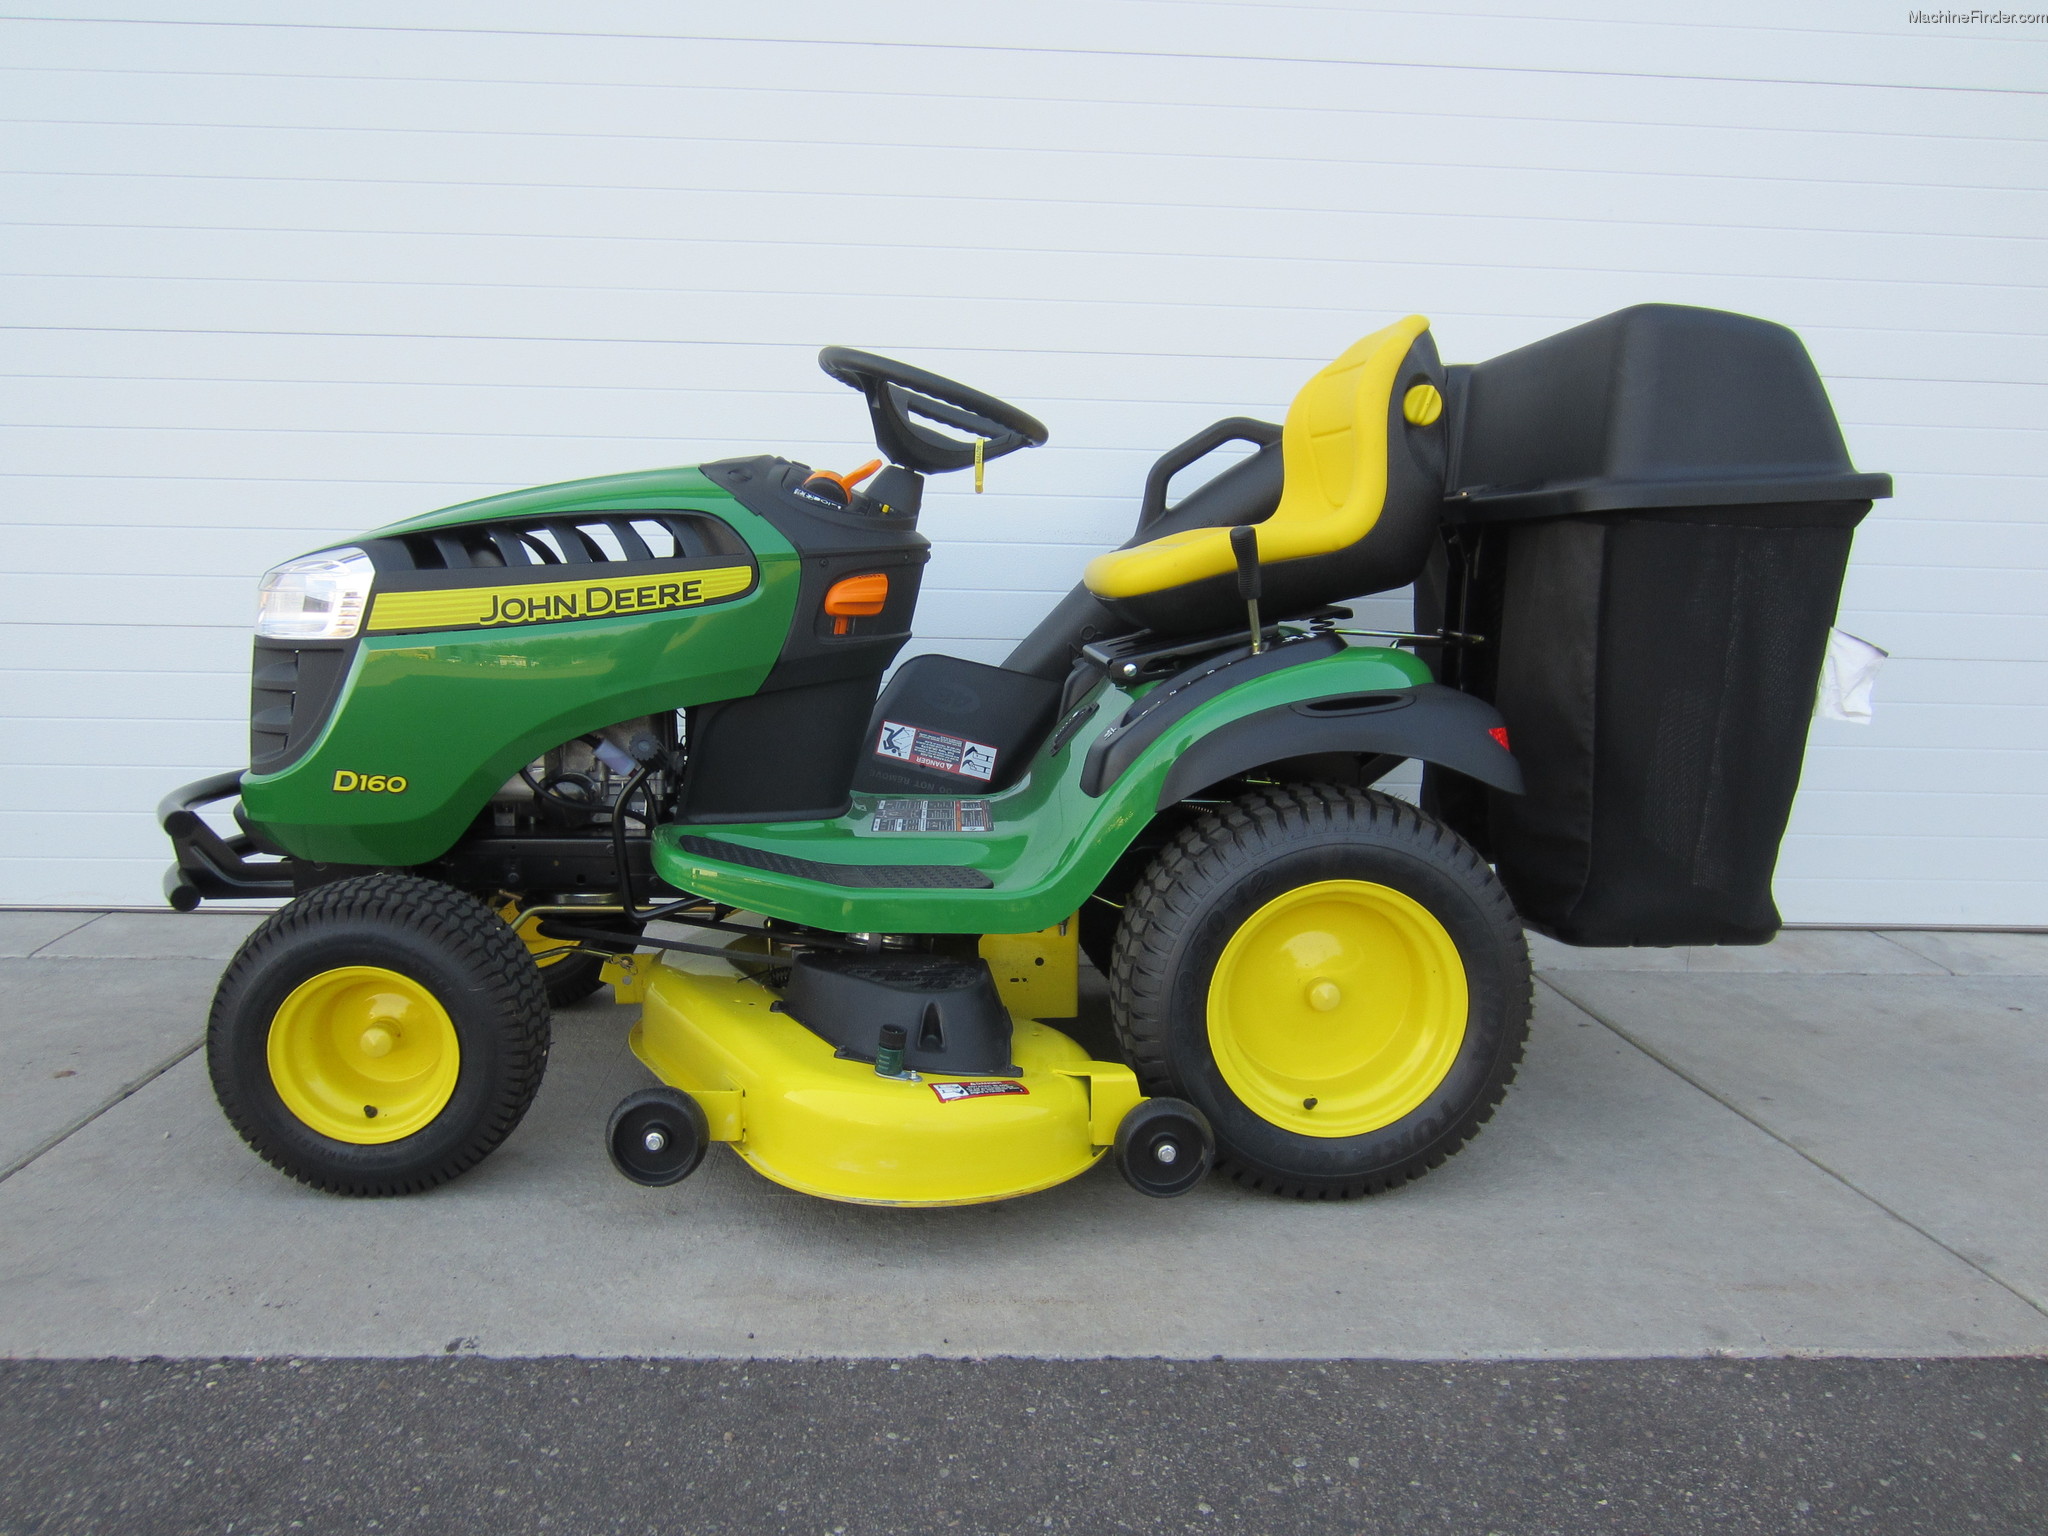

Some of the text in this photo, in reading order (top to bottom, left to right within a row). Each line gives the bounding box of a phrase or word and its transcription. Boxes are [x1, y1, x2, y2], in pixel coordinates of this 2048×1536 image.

[479, 579, 702, 622] JOHN DEERE
[915, 756, 945, 769] DANGER
[332, 769, 407, 793] D160
